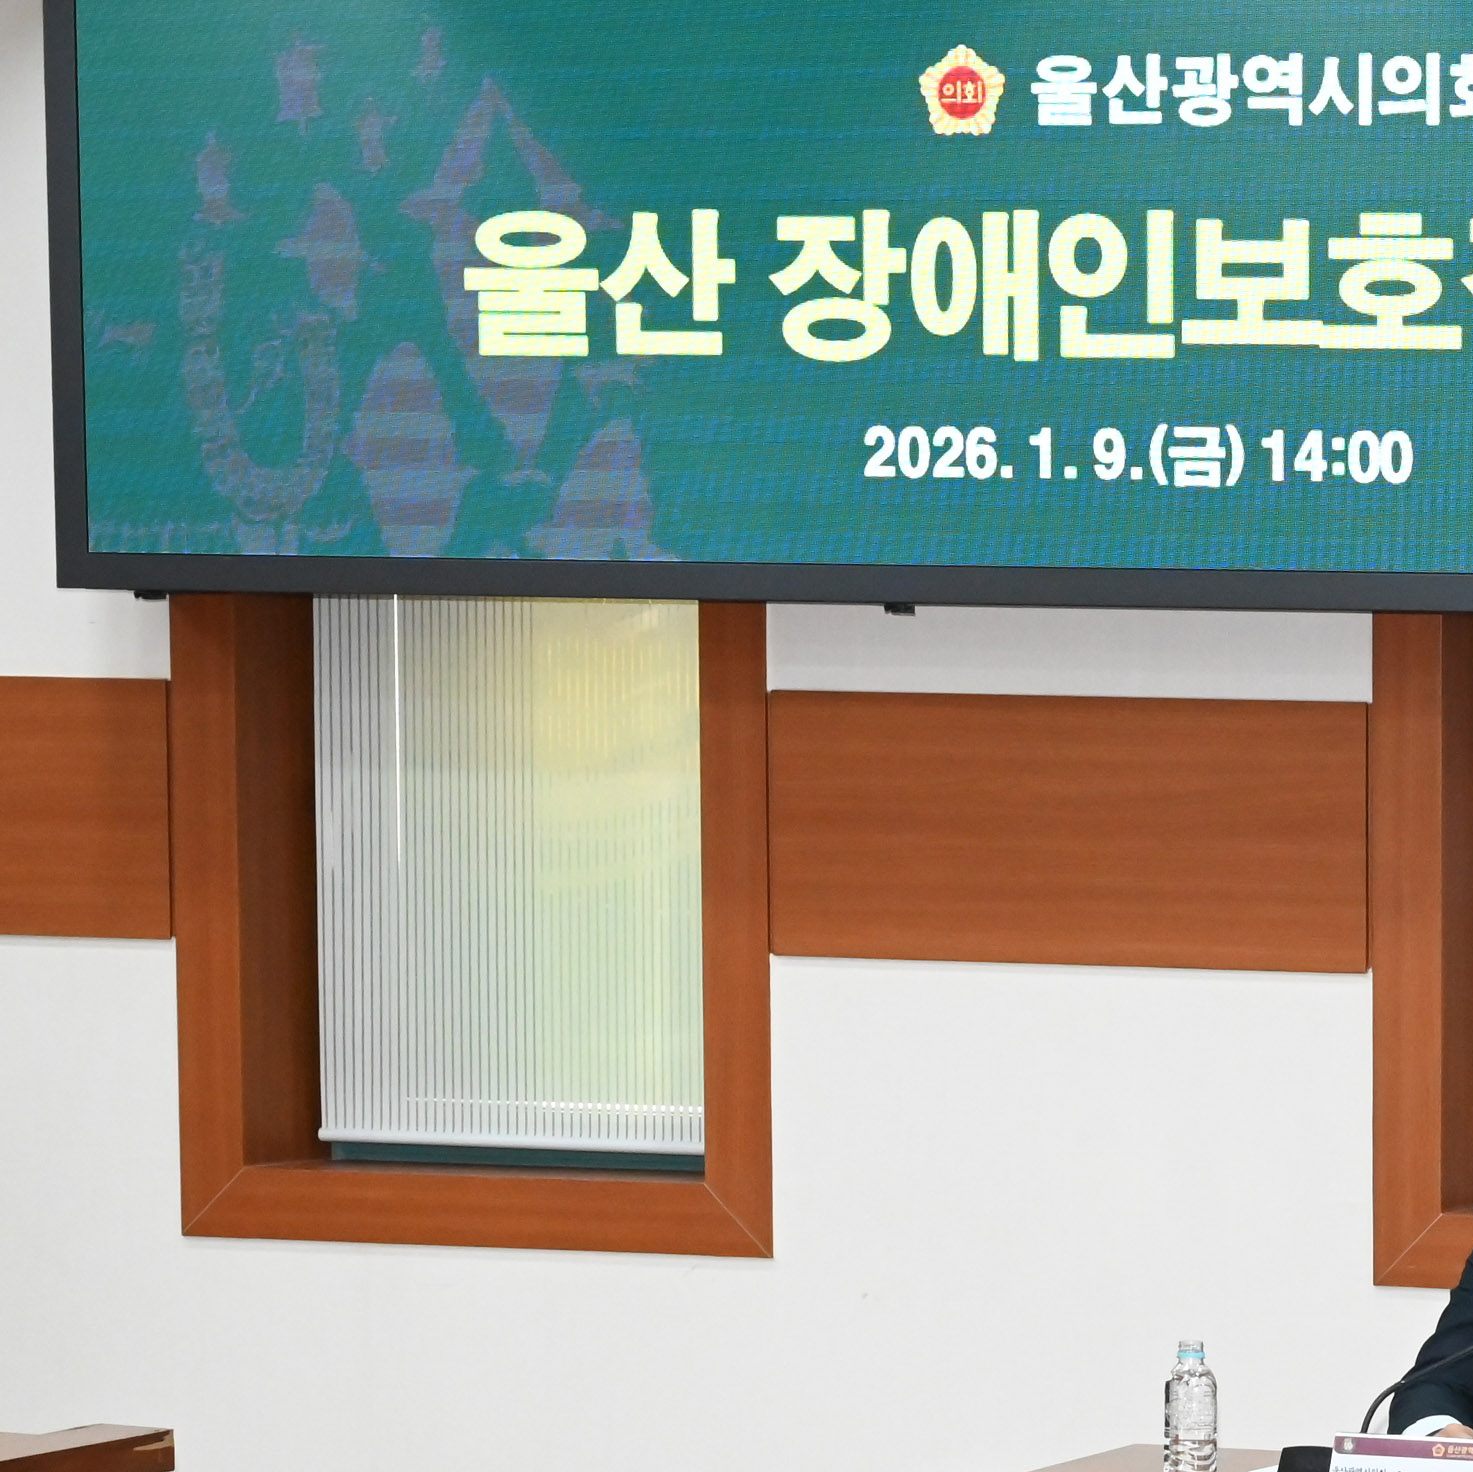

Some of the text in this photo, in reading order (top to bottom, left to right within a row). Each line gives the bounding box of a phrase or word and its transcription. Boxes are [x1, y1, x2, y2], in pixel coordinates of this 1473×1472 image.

[940, 79, 983, 105] 의회
[463, 207, 736, 358] 울산
[864, 423, 1414, 488] 2026. 1. 9.(금) 14:00
